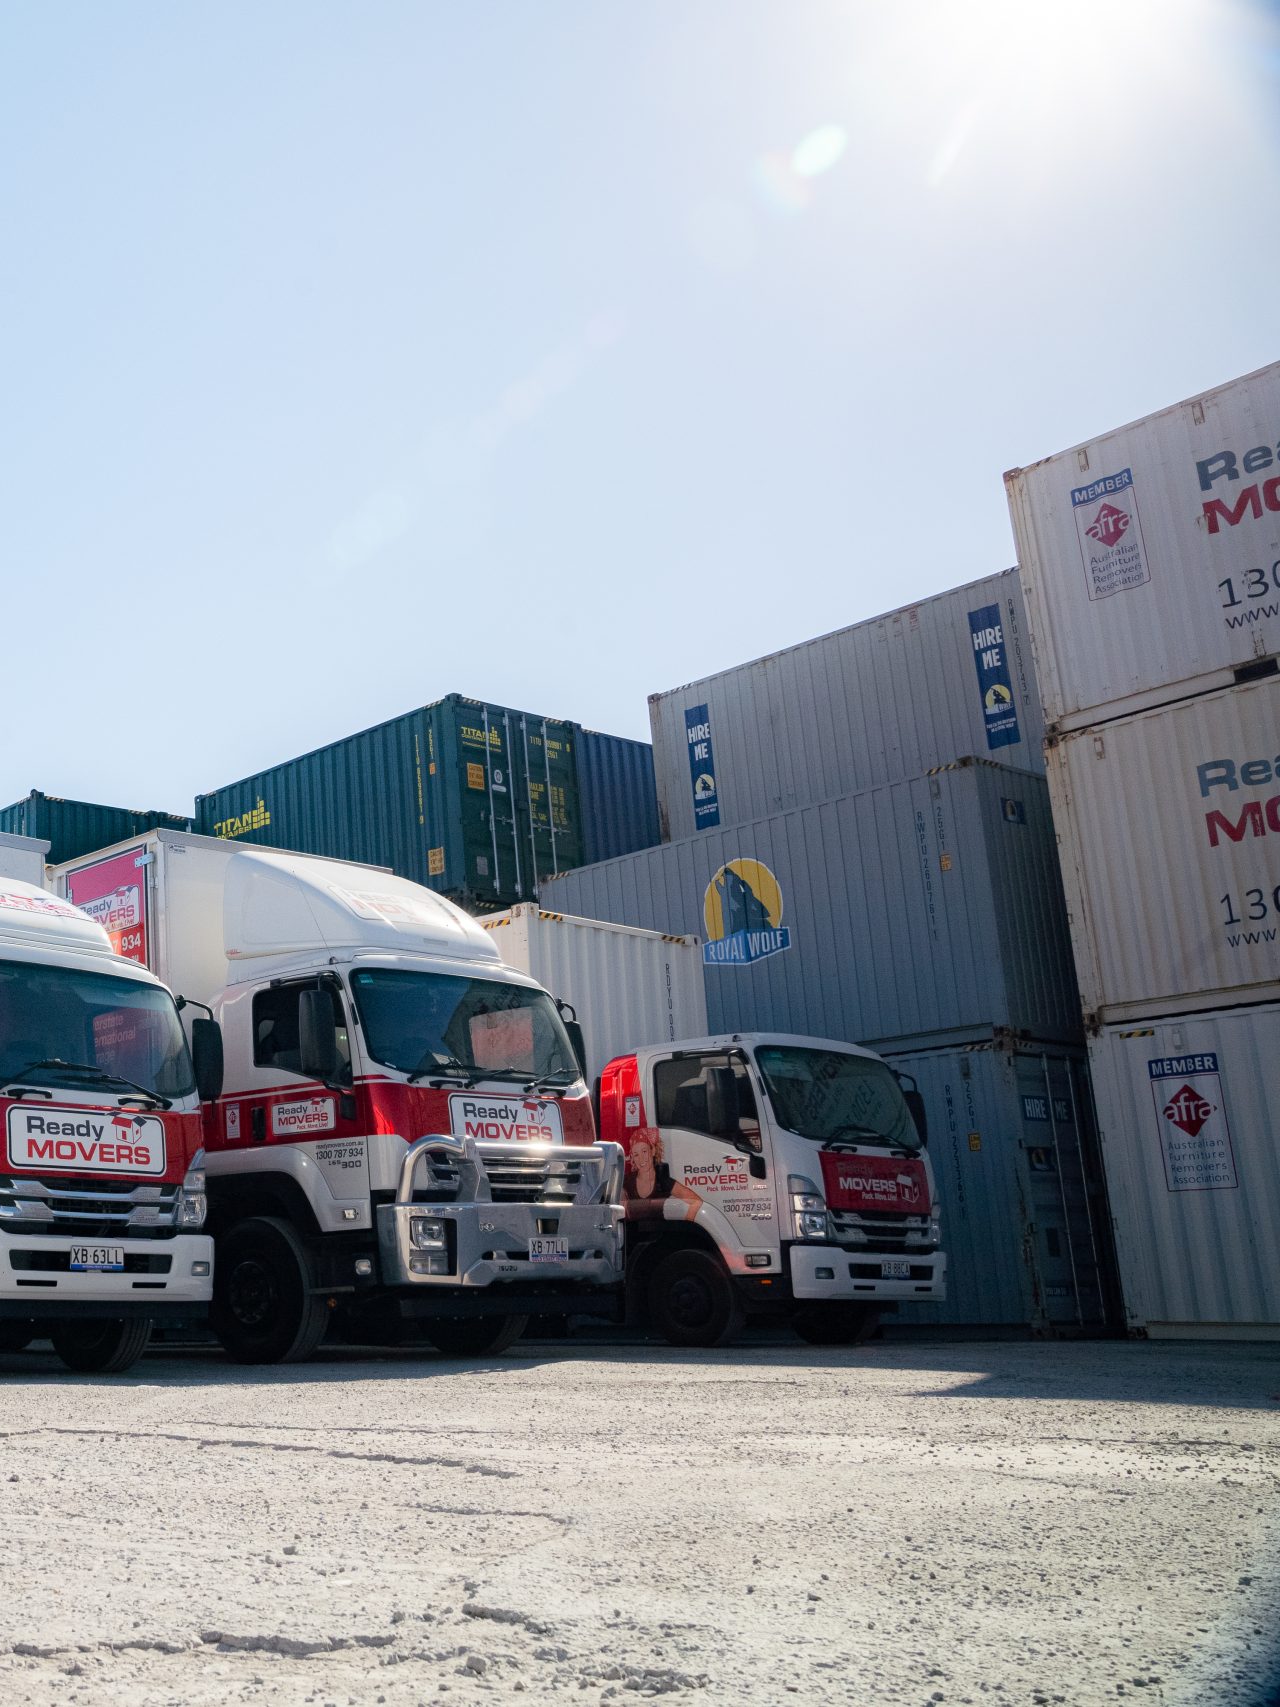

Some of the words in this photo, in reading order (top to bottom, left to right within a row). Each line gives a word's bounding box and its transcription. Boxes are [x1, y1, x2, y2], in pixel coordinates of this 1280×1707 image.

[1196, 442, 1280, 491] Re
[1075, 472, 1130, 503] MEMBER
[1086, 509, 1132, 540] afra
[1090, 543, 1139, 565] Australian
[1091, 553, 1140, 575] Furniture
[1092, 564, 1142, 584] Removers
[1094, 572, 1144, 594] Association
[972, 626, 1003, 650] HIRE
[982, 648, 1001, 670] ME
[688, 723, 711, 743] HIRE
[694, 743, 709, 760] ME
[1197, 755, 1280, 797] Re
[214, 811, 252, 836] TITAN
[122, 932, 141, 952] 934
[708, 937, 746, 961] ROYAL
[747, 929, 785, 957] WOLF
[1152, 1057, 1214, 1076] MEMBER
[278, 1105, 308, 1115] Ready
[463, 1102, 518, 1122] Ready
[945, 1085, 956, 1132] RWPU
[965, 1081, 976, 1129] 25G1
[1024, 1098, 1047, 1120] HIRE
[1164, 1094, 1215, 1122] afra
[26, 1115, 104, 1141] Ready
[278, 1113, 328, 1126] MOVERS
[465, 1121, 553, 1141] MOVERS
[27, 1139, 151, 1165] MOVERS
[315, 1150, 332, 1160] 1300
[333, 1149, 347, 1159] 787
[348, 1147, 363, 1157] 934
[316, 1141, 364, 1150] readymovers.com.au
[1168, 1138, 1224, 1150] Australian
[341, 1160, 361, 1168] 300
[1169, 1149, 1225, 1161] Furniture
[684, 1164, 722, 1175] Ready
[1171, 1161, 1228, 1173] Removers
[685, 1174, 748, 1186] MOVERS
[839, 1177, 897, 1193] MOVERS
[1173, 1173, 1230, 1184] Association
[723, 1204, 741, 1213] 1300
[742, 1203, 756, 1212] 787
[756, 1202, 772, 1212] 934
